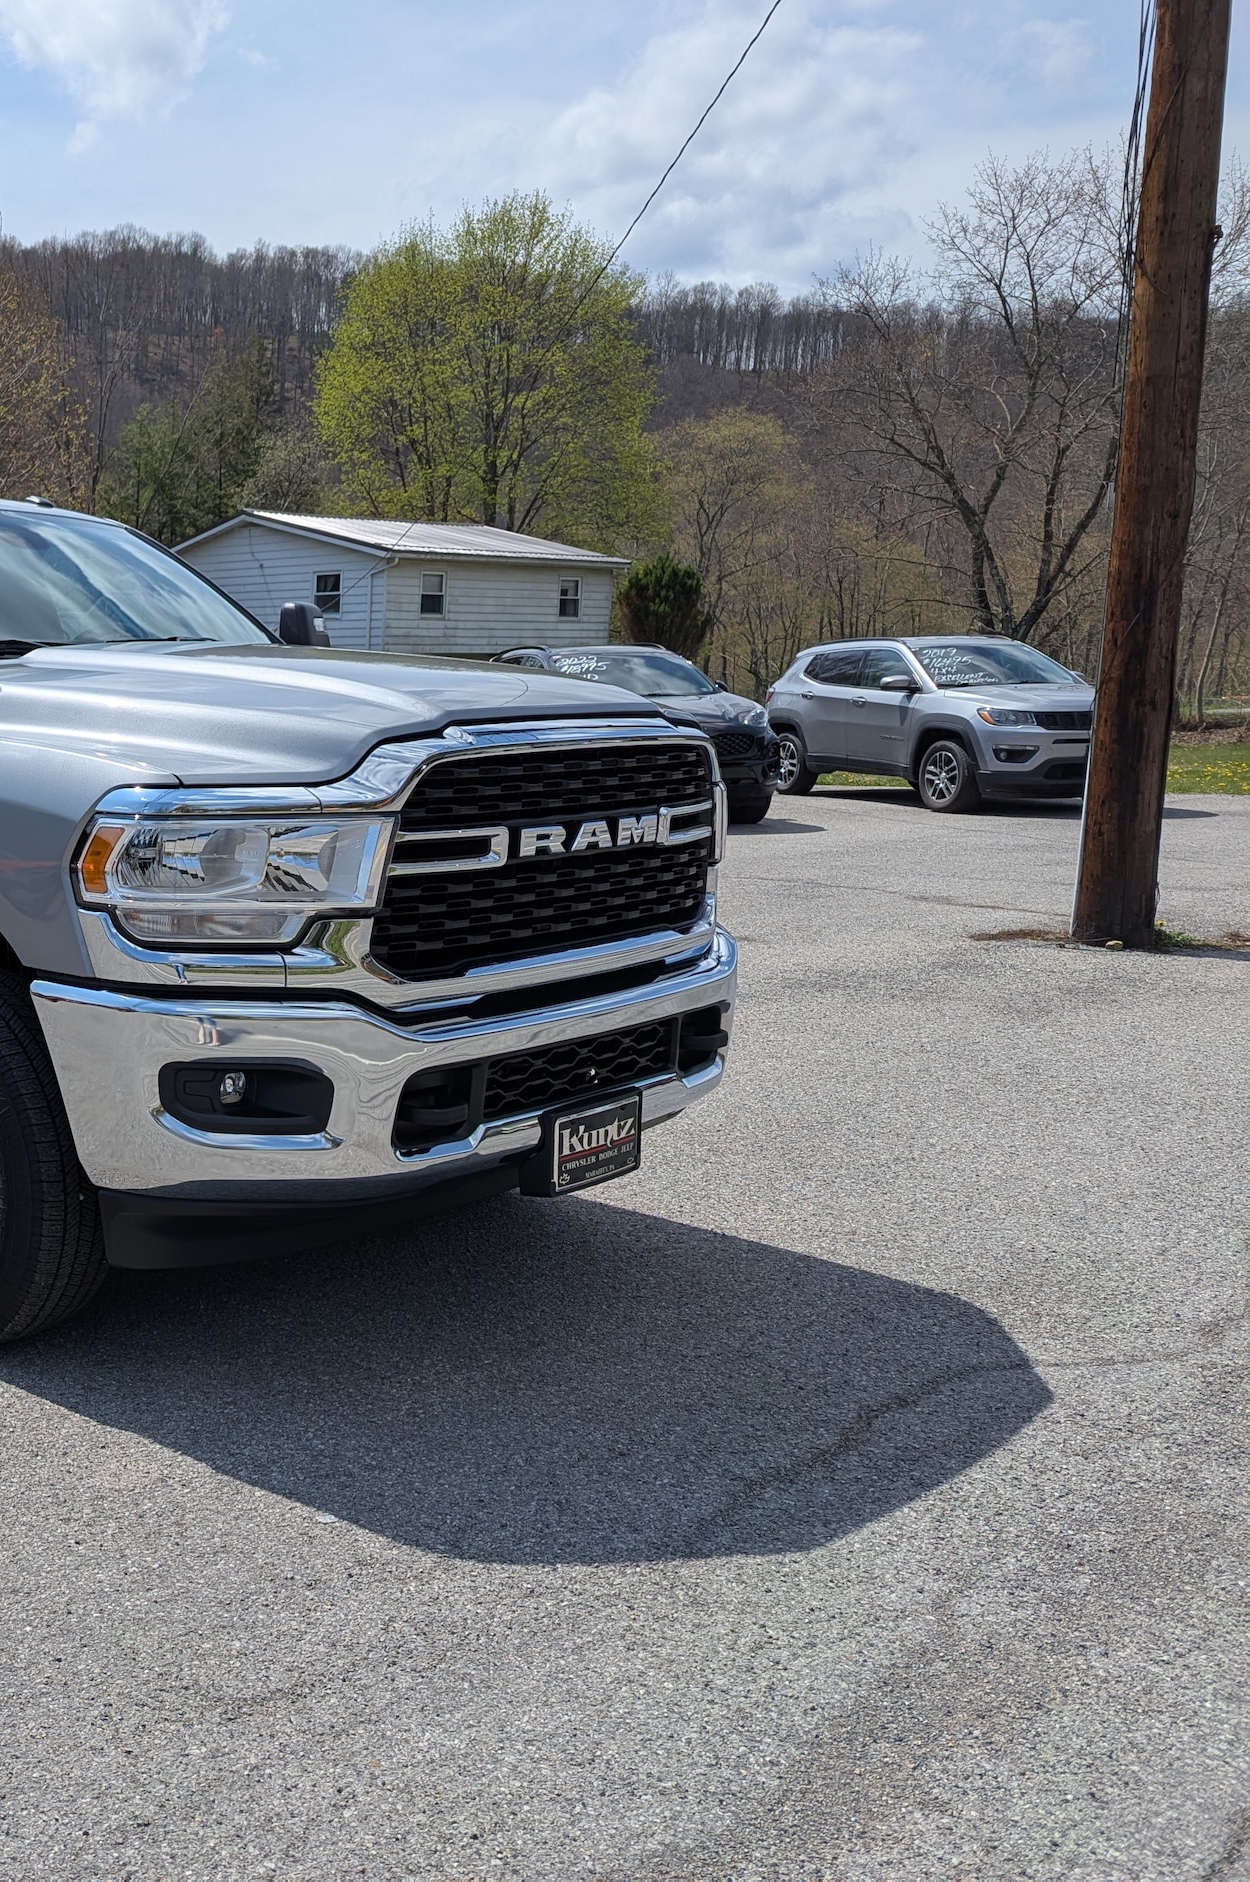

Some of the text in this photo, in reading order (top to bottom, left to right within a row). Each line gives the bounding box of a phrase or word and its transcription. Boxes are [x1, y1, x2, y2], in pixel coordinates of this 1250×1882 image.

[920, 647, 957, 660] 2019
[556, 655, 598, 667] 2022
[519, 813, 659, 858] RAM
[559, 1116, 635, 1157] Kuntz
[598, 1148, 619, 1161] DODGE
